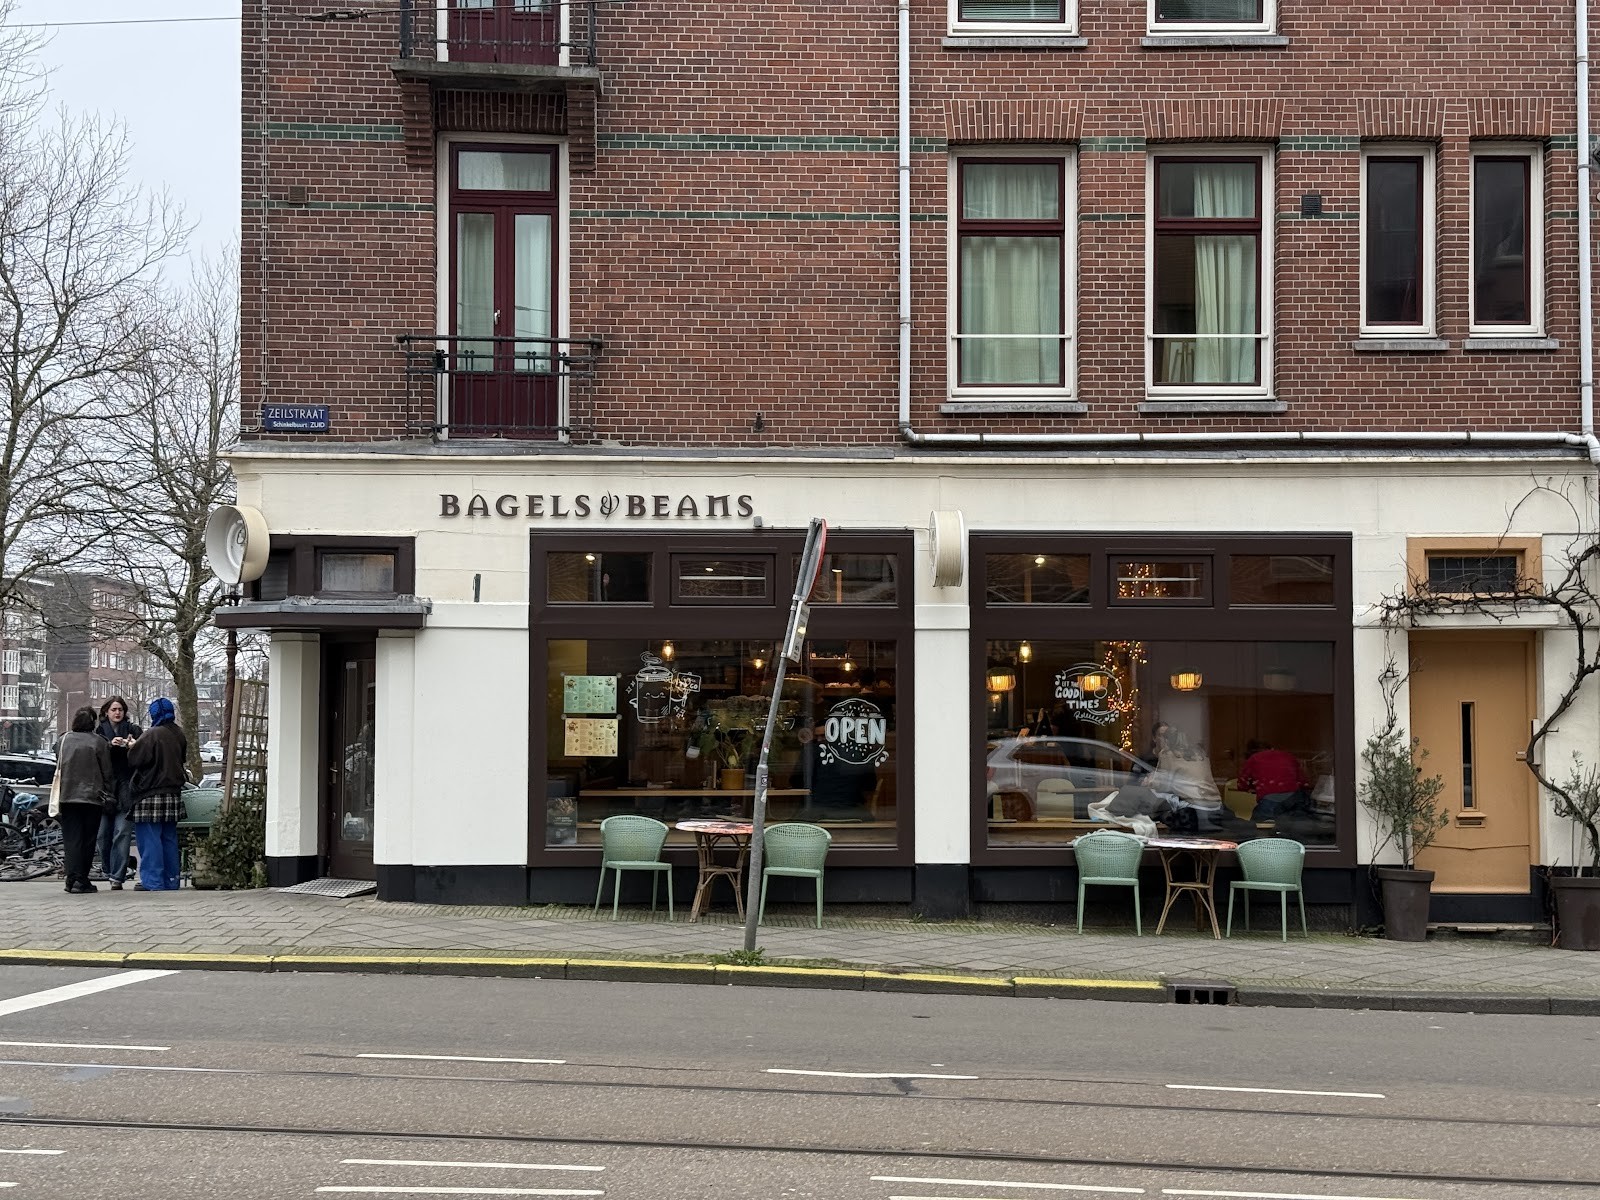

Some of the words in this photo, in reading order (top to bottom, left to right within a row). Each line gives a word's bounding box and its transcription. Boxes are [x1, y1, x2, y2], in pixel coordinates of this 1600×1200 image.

[268, 408, 325, 419] ZEILSTRAAT
[438, 493, 591, 518] BAGELS
[624, 493, 754, 518] BEANS
[1055, 686, 1079, 698] GOOD
[1066, 700, 1100, 709] TIMES
[825, 717, 886, 744] OPEN
